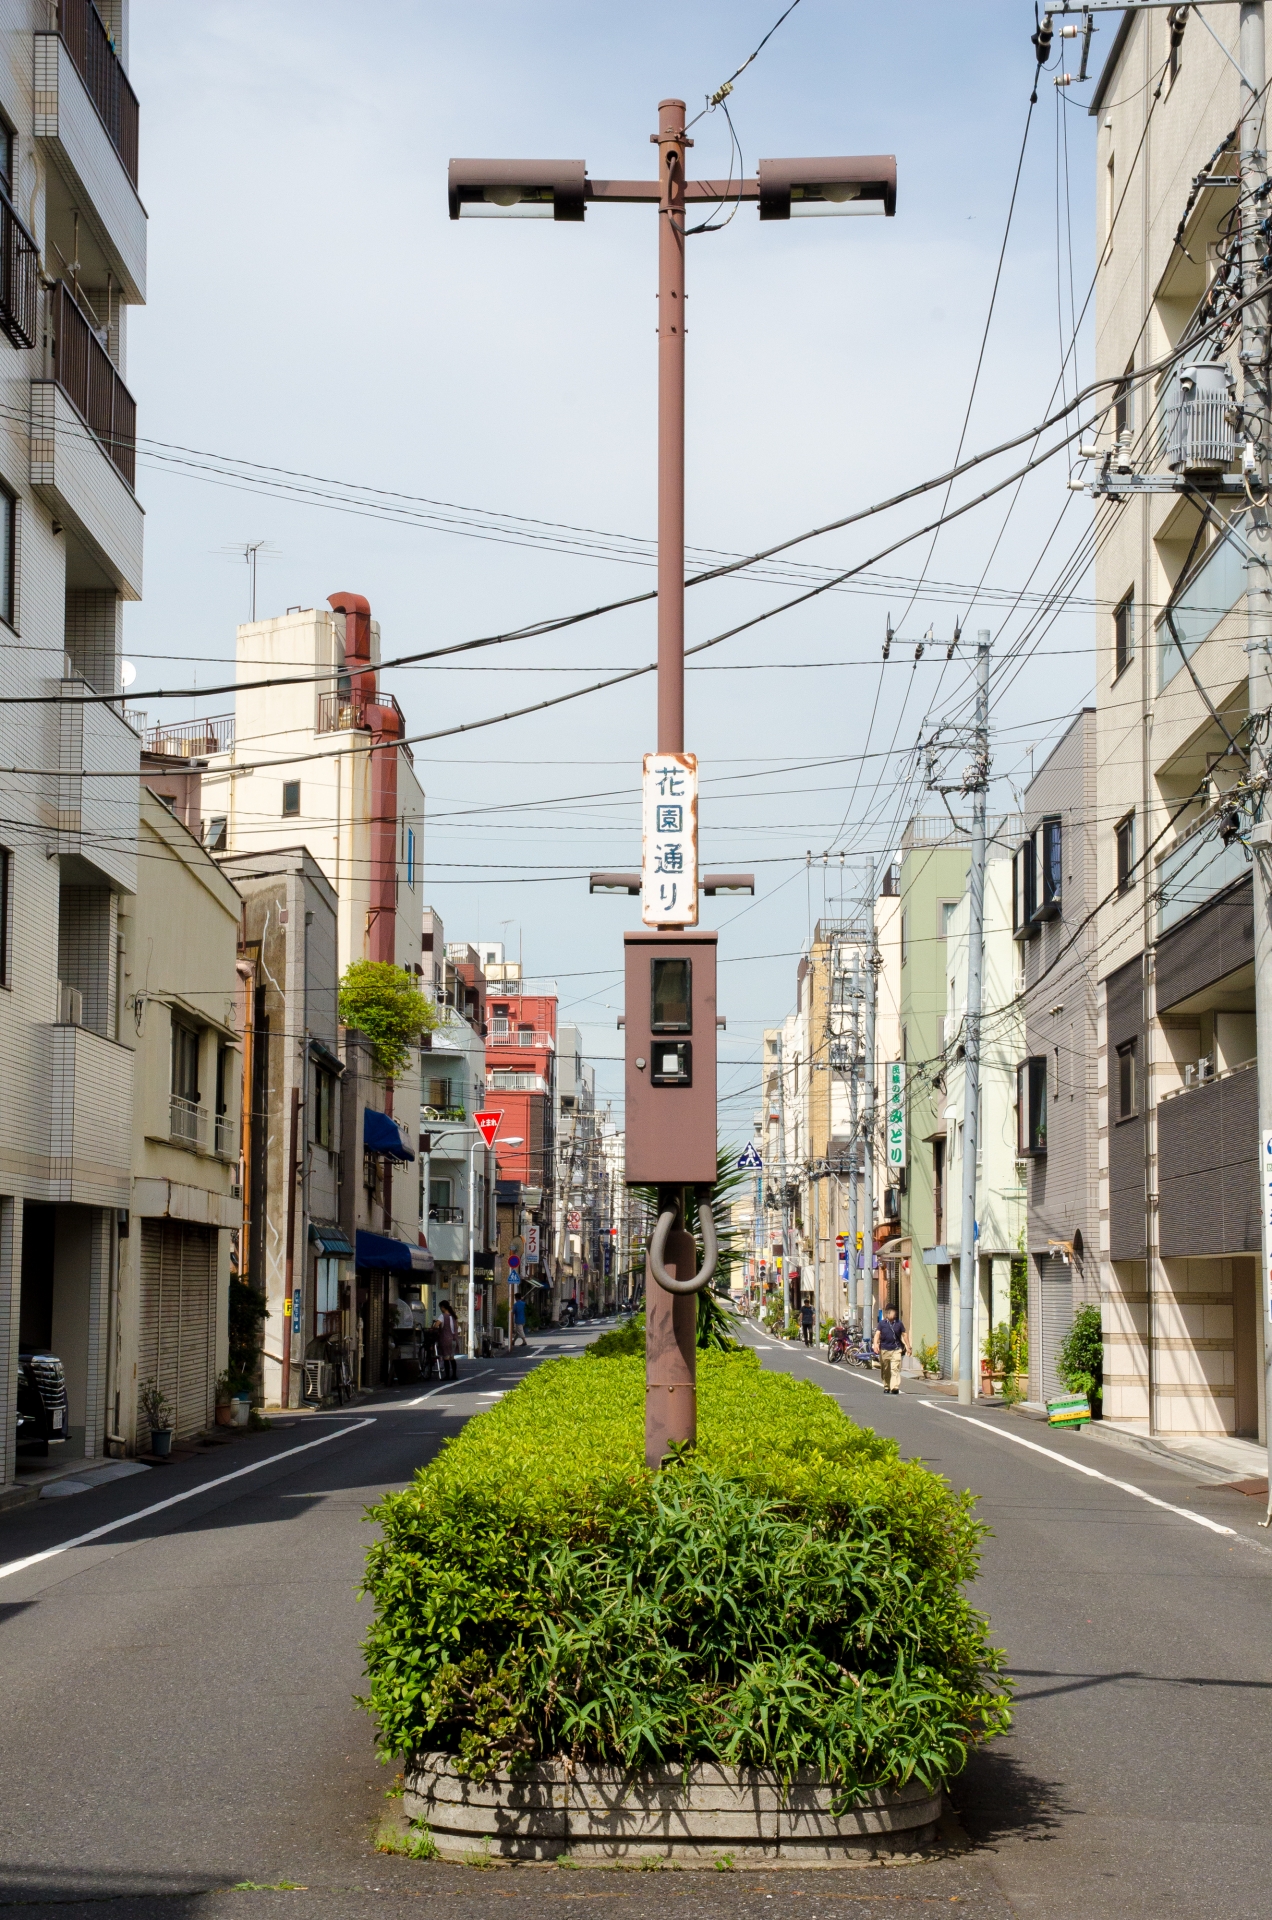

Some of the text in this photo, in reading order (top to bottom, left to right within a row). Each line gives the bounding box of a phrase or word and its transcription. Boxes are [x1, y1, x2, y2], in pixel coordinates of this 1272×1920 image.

[654, 766, 685, 911] 花園通り
[480, 1118, 497, 1127] 止まれ
[889, 1108, 903, 1163] みどり
[528, 1227, 537, 1253] クスリ
